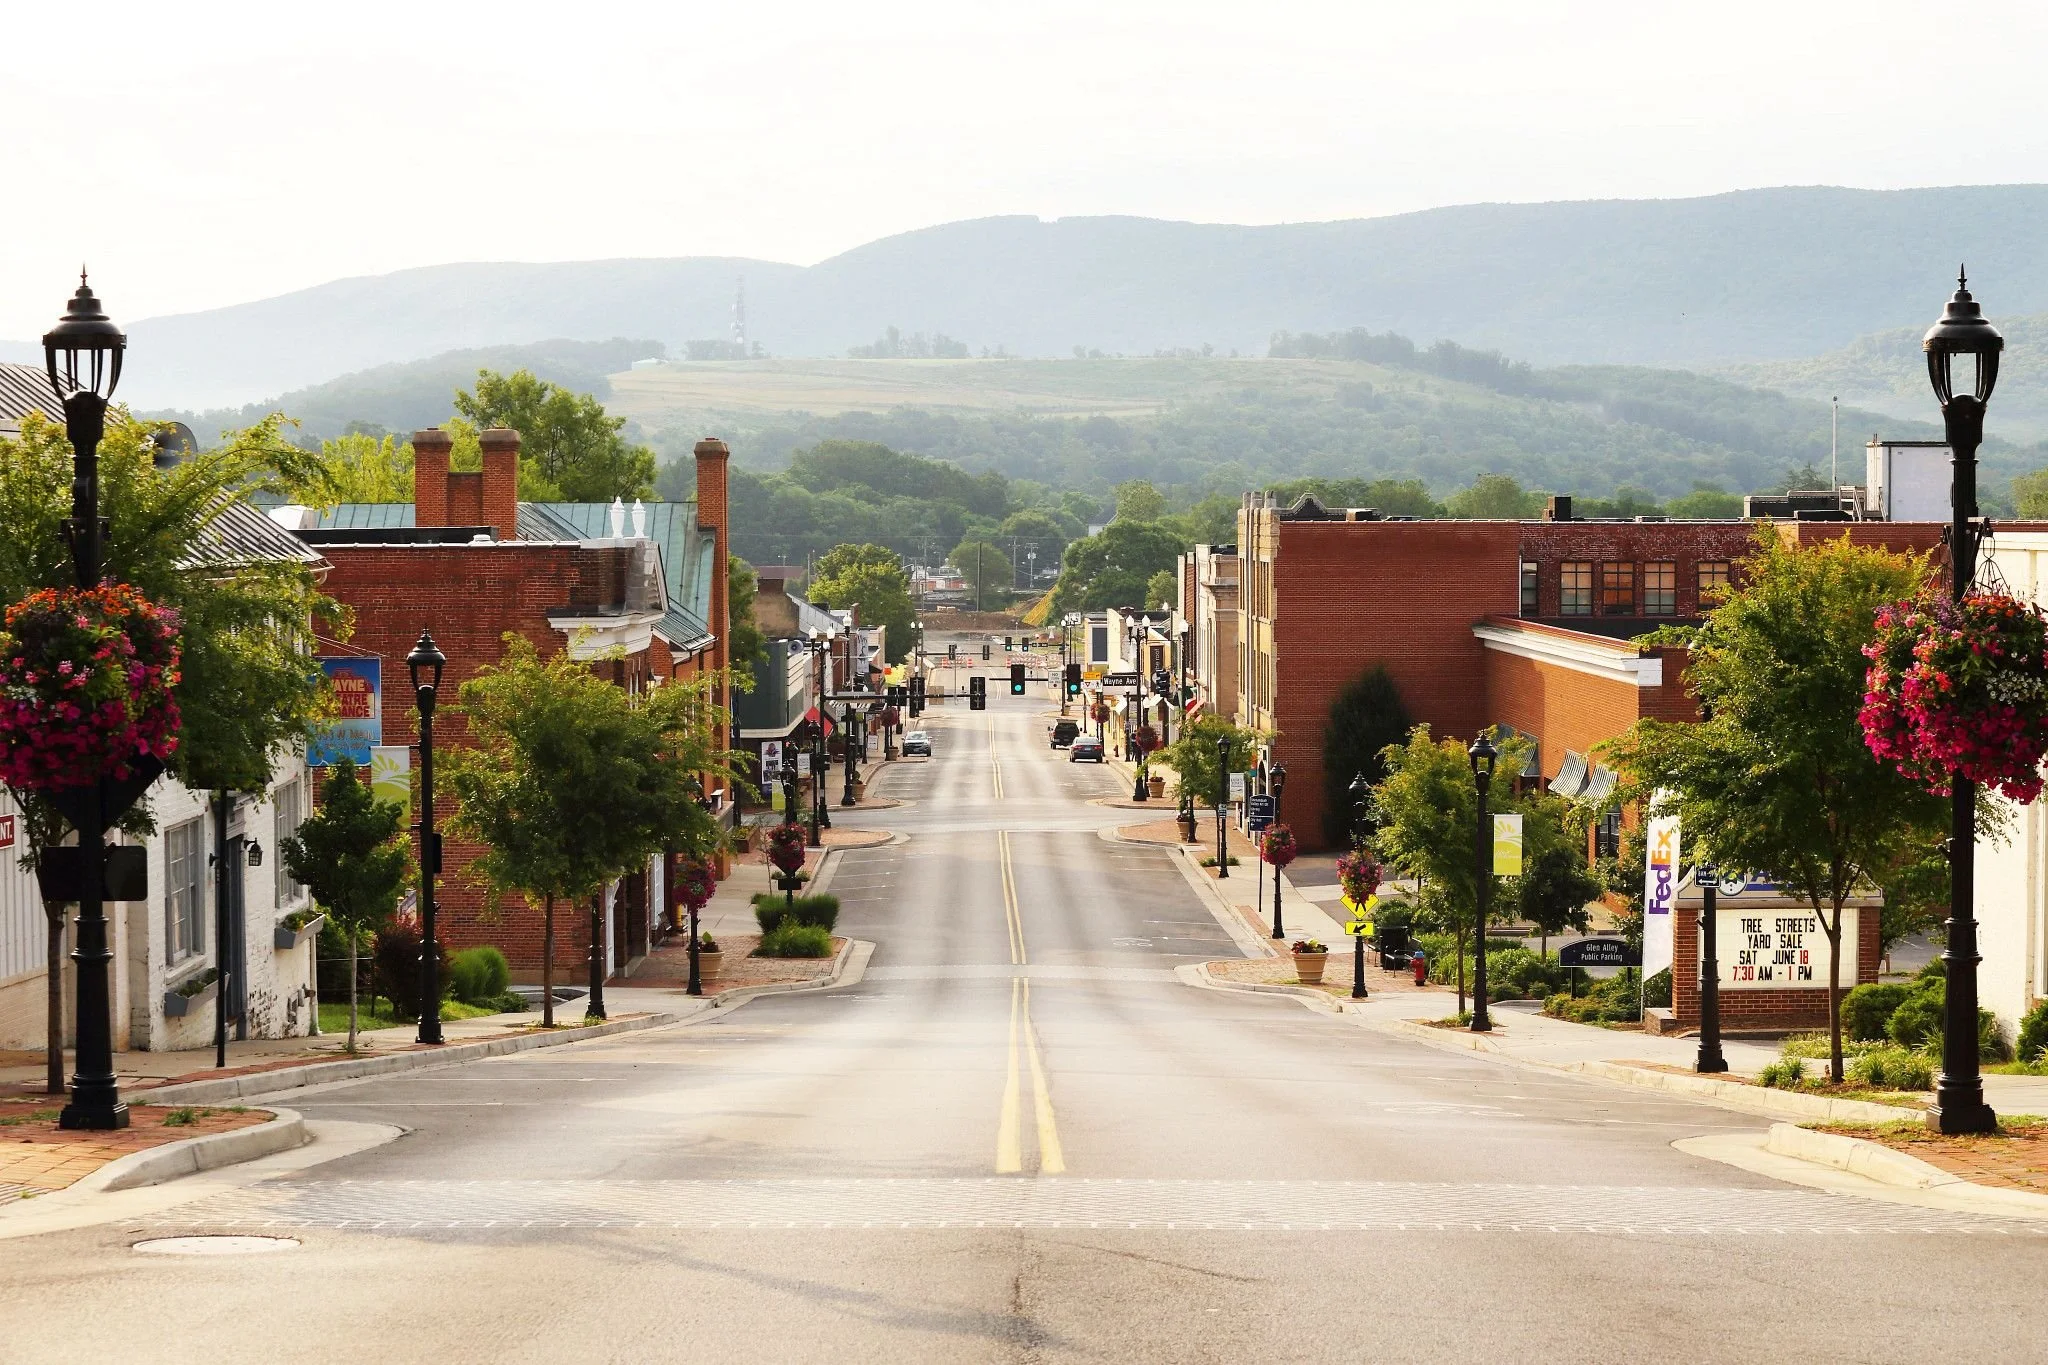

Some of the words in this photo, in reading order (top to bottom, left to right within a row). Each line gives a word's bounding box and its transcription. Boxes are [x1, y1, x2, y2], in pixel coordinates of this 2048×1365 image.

[1103, 677, 1123, 687] Wayne
[1125, 677, 1137, 685] Ave
[336, 693, 368, 706] ATRE
[338, 706, 371, 718] ANCE
[1648, 829, 1672, 915] FedEx
[1741, 918, 1763, 933] TREE
[1775, 918, 1816, 933] STREETS
[1586, 943, 1601, 952] Glen
[1602, 943, 1619, 953] Alley
[1748, 934, 1771, 949] YARD
[1780, 934, 1803, 949] SALE
[1581, 953, 1599, 961] Public
[1600, 953, 1623, 962] Parking
[1739, 950, 1757, 965] SAT
[1772, 950, 1796, 965] JUNE
[1799, 950, 1809, 965] 18
[1732, 966, 1754, 981] 7:30
[1758, 966, 1773, 981] AM
[1788, 966, 1792, 981] 1
[1797, 966, 1812, 981] PM
